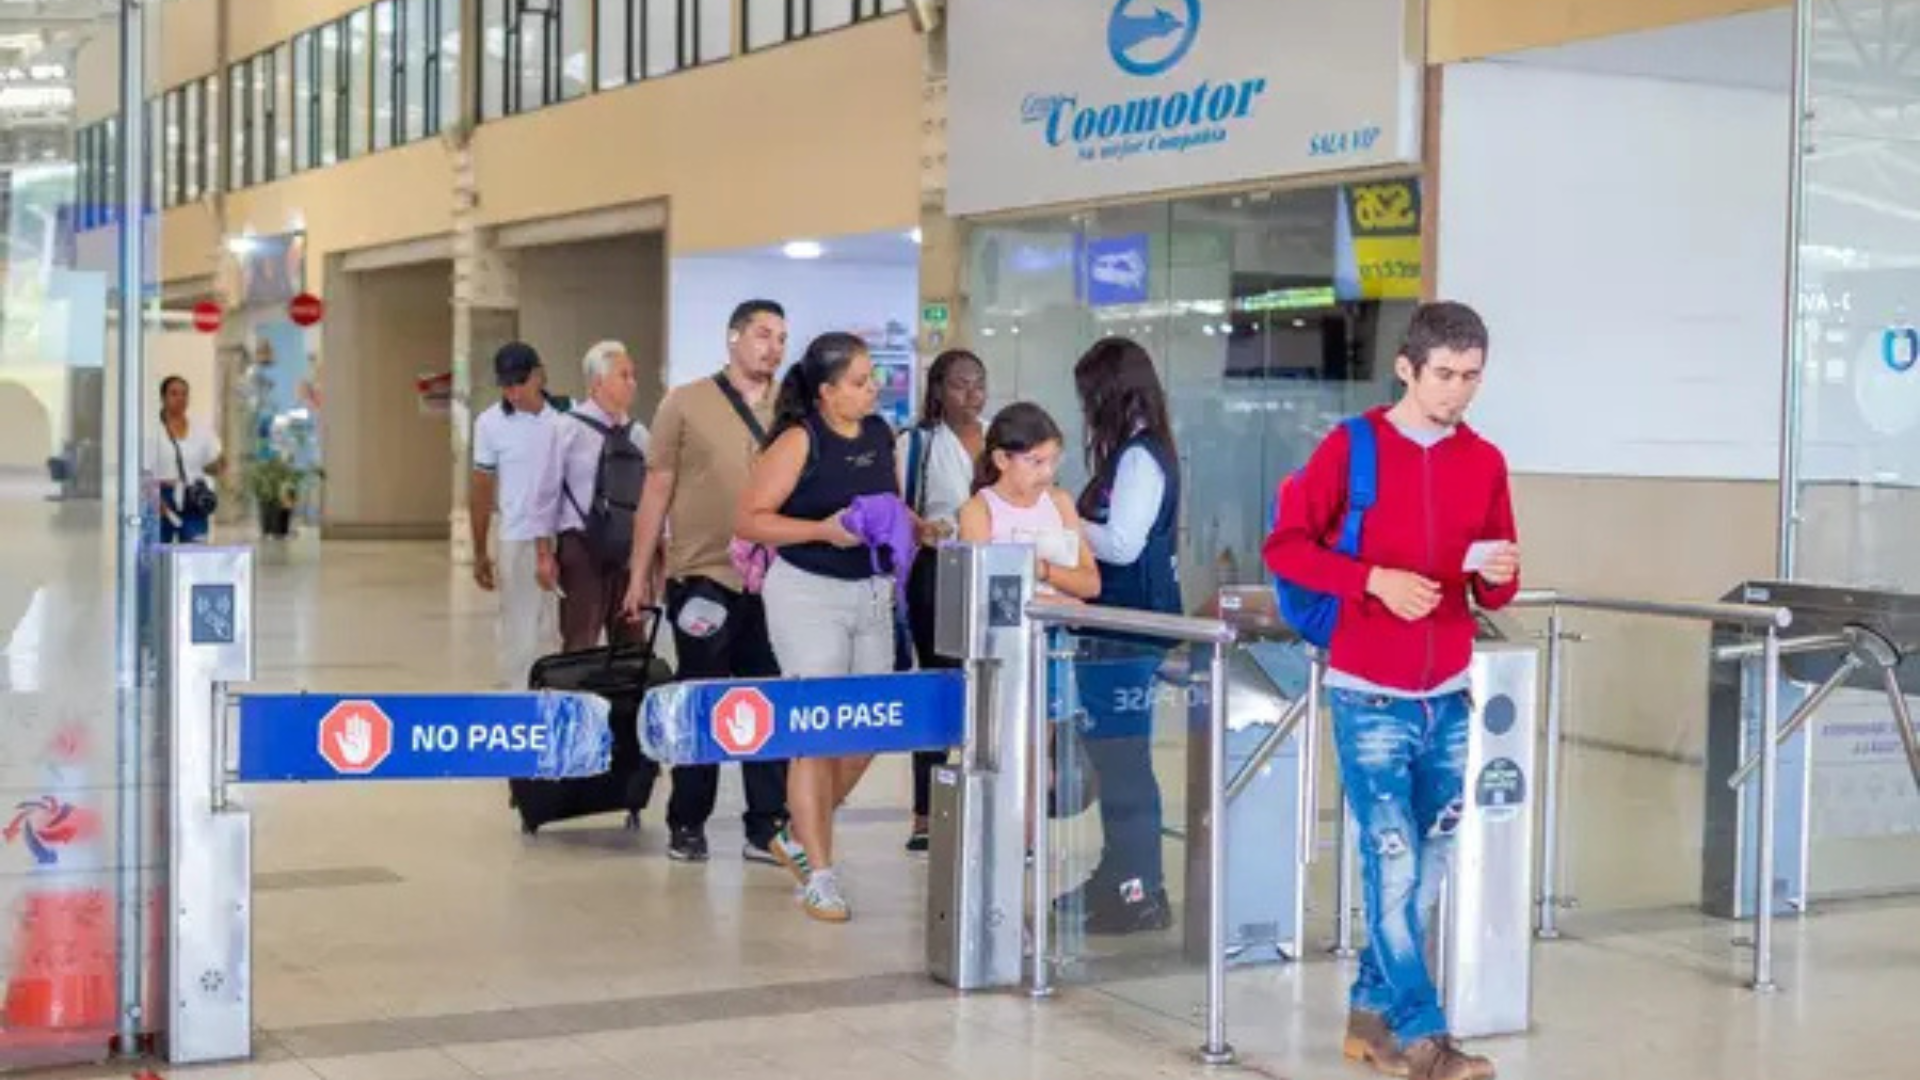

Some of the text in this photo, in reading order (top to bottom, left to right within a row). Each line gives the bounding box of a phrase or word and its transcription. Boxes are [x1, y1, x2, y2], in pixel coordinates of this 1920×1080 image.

[1046, 78, 1265, 146] Coomotor
[789, 702, 904, 733] NO PASE
[411, 724, 548, 752] NO PASE
